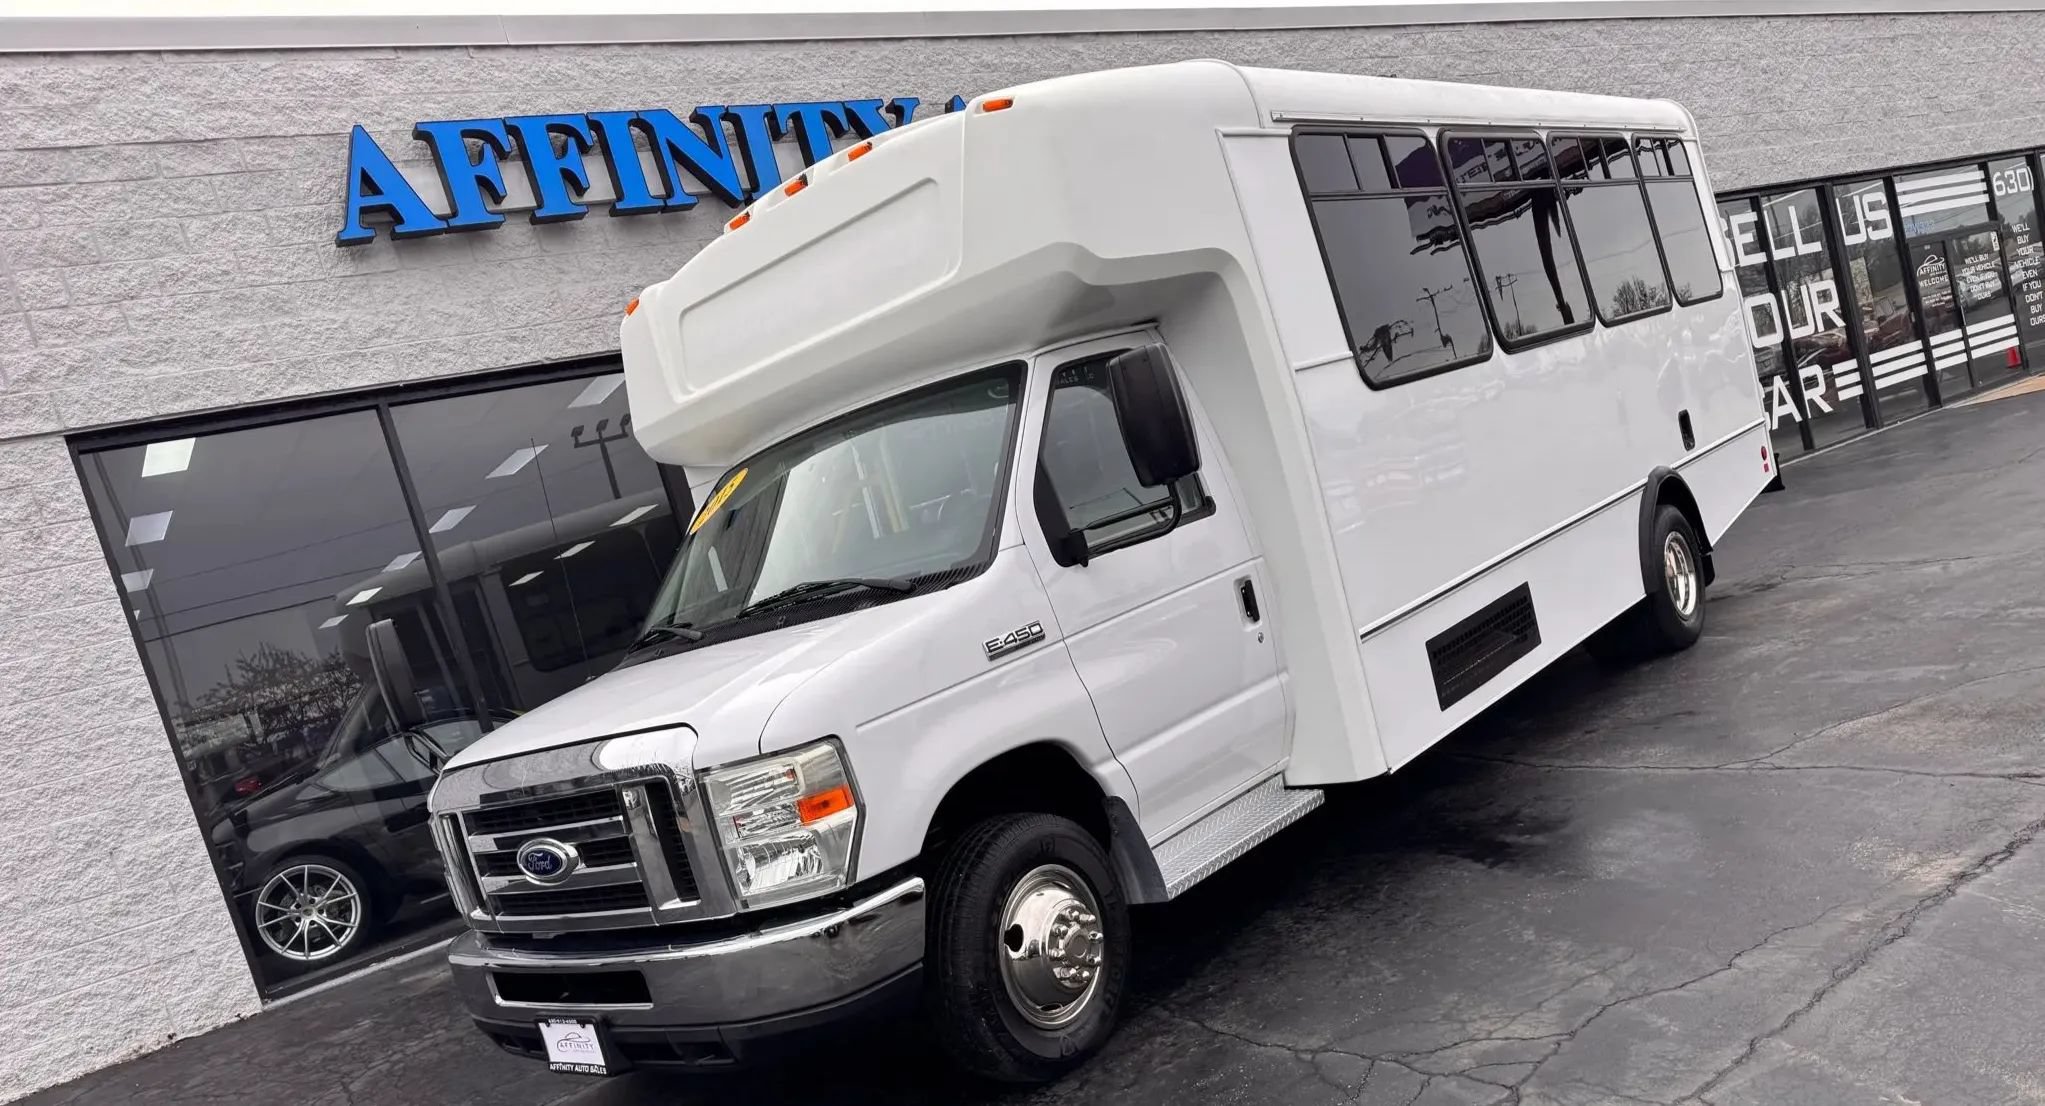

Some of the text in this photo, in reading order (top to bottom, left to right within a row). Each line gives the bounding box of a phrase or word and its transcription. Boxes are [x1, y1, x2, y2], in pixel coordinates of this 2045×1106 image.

[1835, 191, 1894, 246] US
[2016, 234, 2029, 245] BUY
[2017, 246, 2034, 257] YOUR
[2022, 270, 2038, 280] EVEN
[1919, 275, 1948, 288] WELCOME
[2022, 279, 2042, 292] IF YOU
[2030, 303, 2043, 314] BUY
[984, 622, 1044, 654] E-450
[527, 852, 553, 872] Ford
[559, 1041, 595, 1051] AFFINITY
[549, 1063, 607, 1075] AFFINITY AUTO SALES
